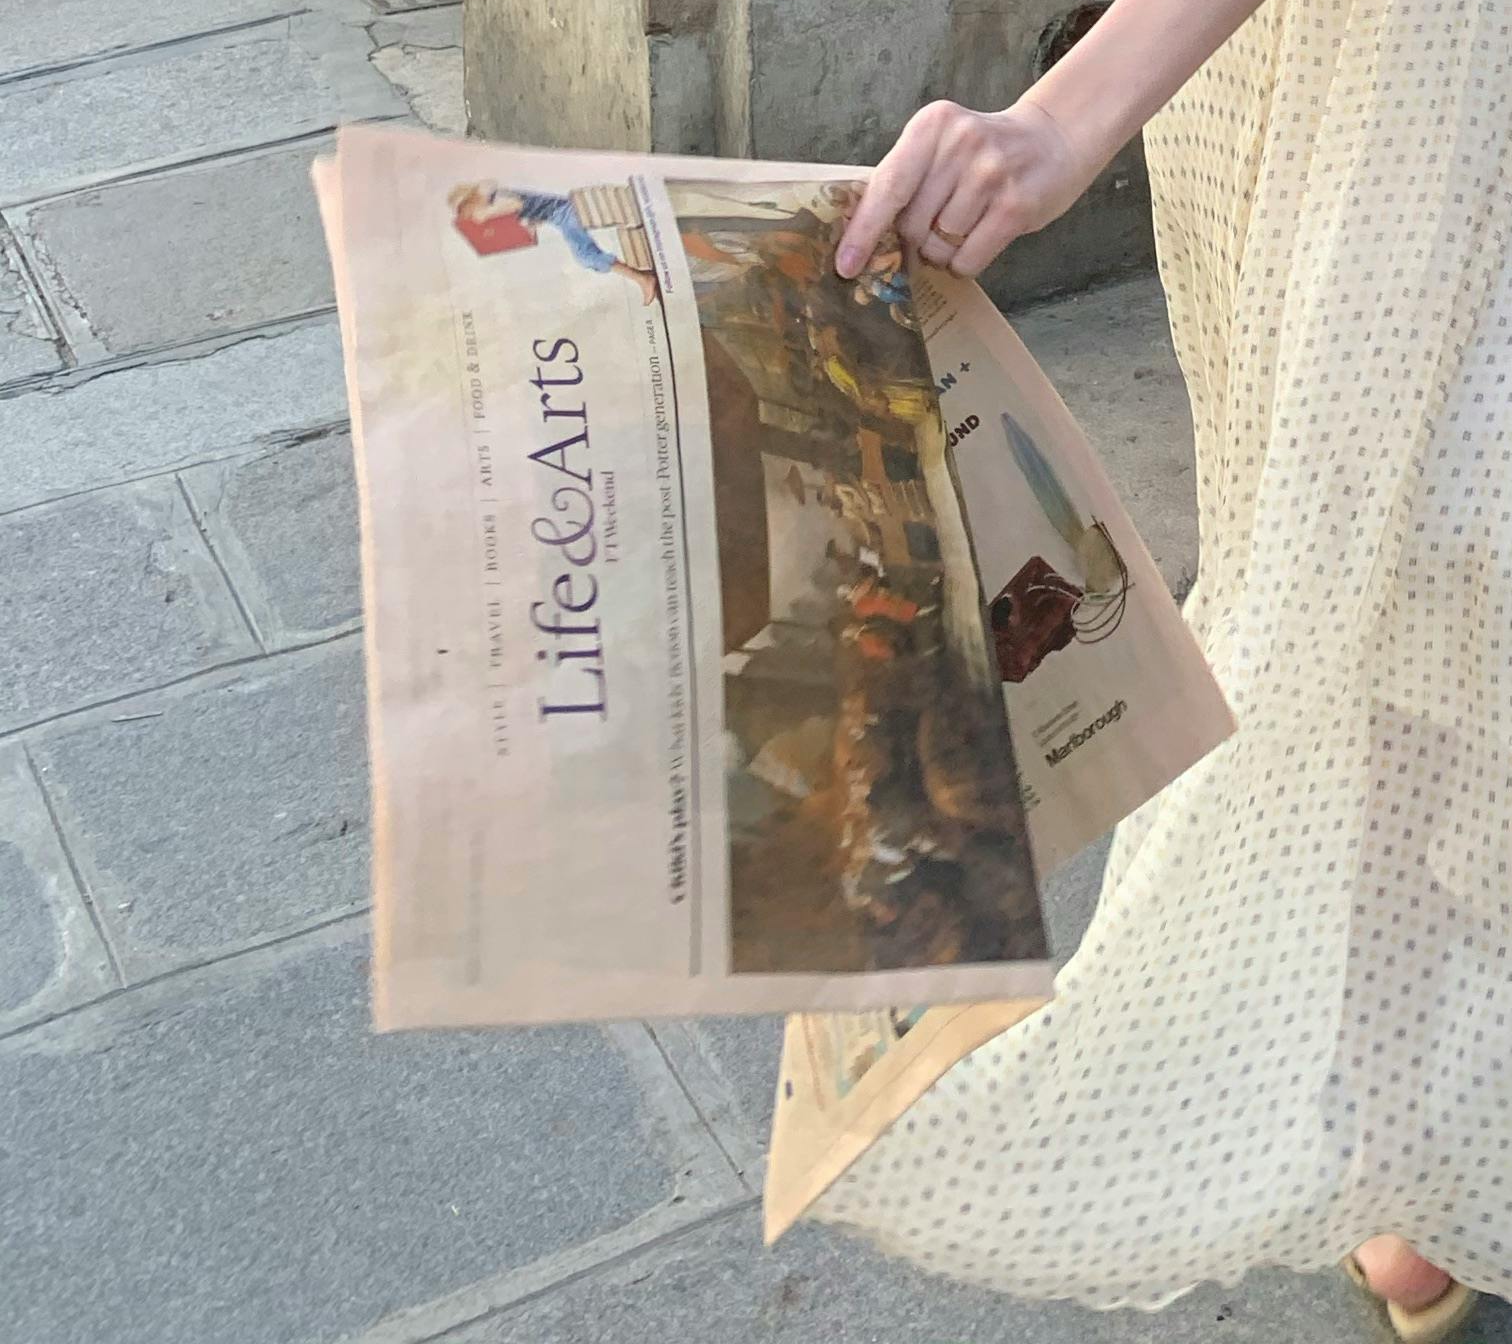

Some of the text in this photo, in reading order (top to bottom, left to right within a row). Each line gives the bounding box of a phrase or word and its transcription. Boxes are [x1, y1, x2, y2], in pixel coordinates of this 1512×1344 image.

[461, 309, 479, 357] DRINK
[470, 378, 486, 420] FOOD
[647, 355, 670, 432] generation
[477, 444, 493, 487] ARTS
[481, 513, 499, 572] BOOKS
[659, 522, 674, 547] the
[1045, 699, 1128, 768] Marlborough
